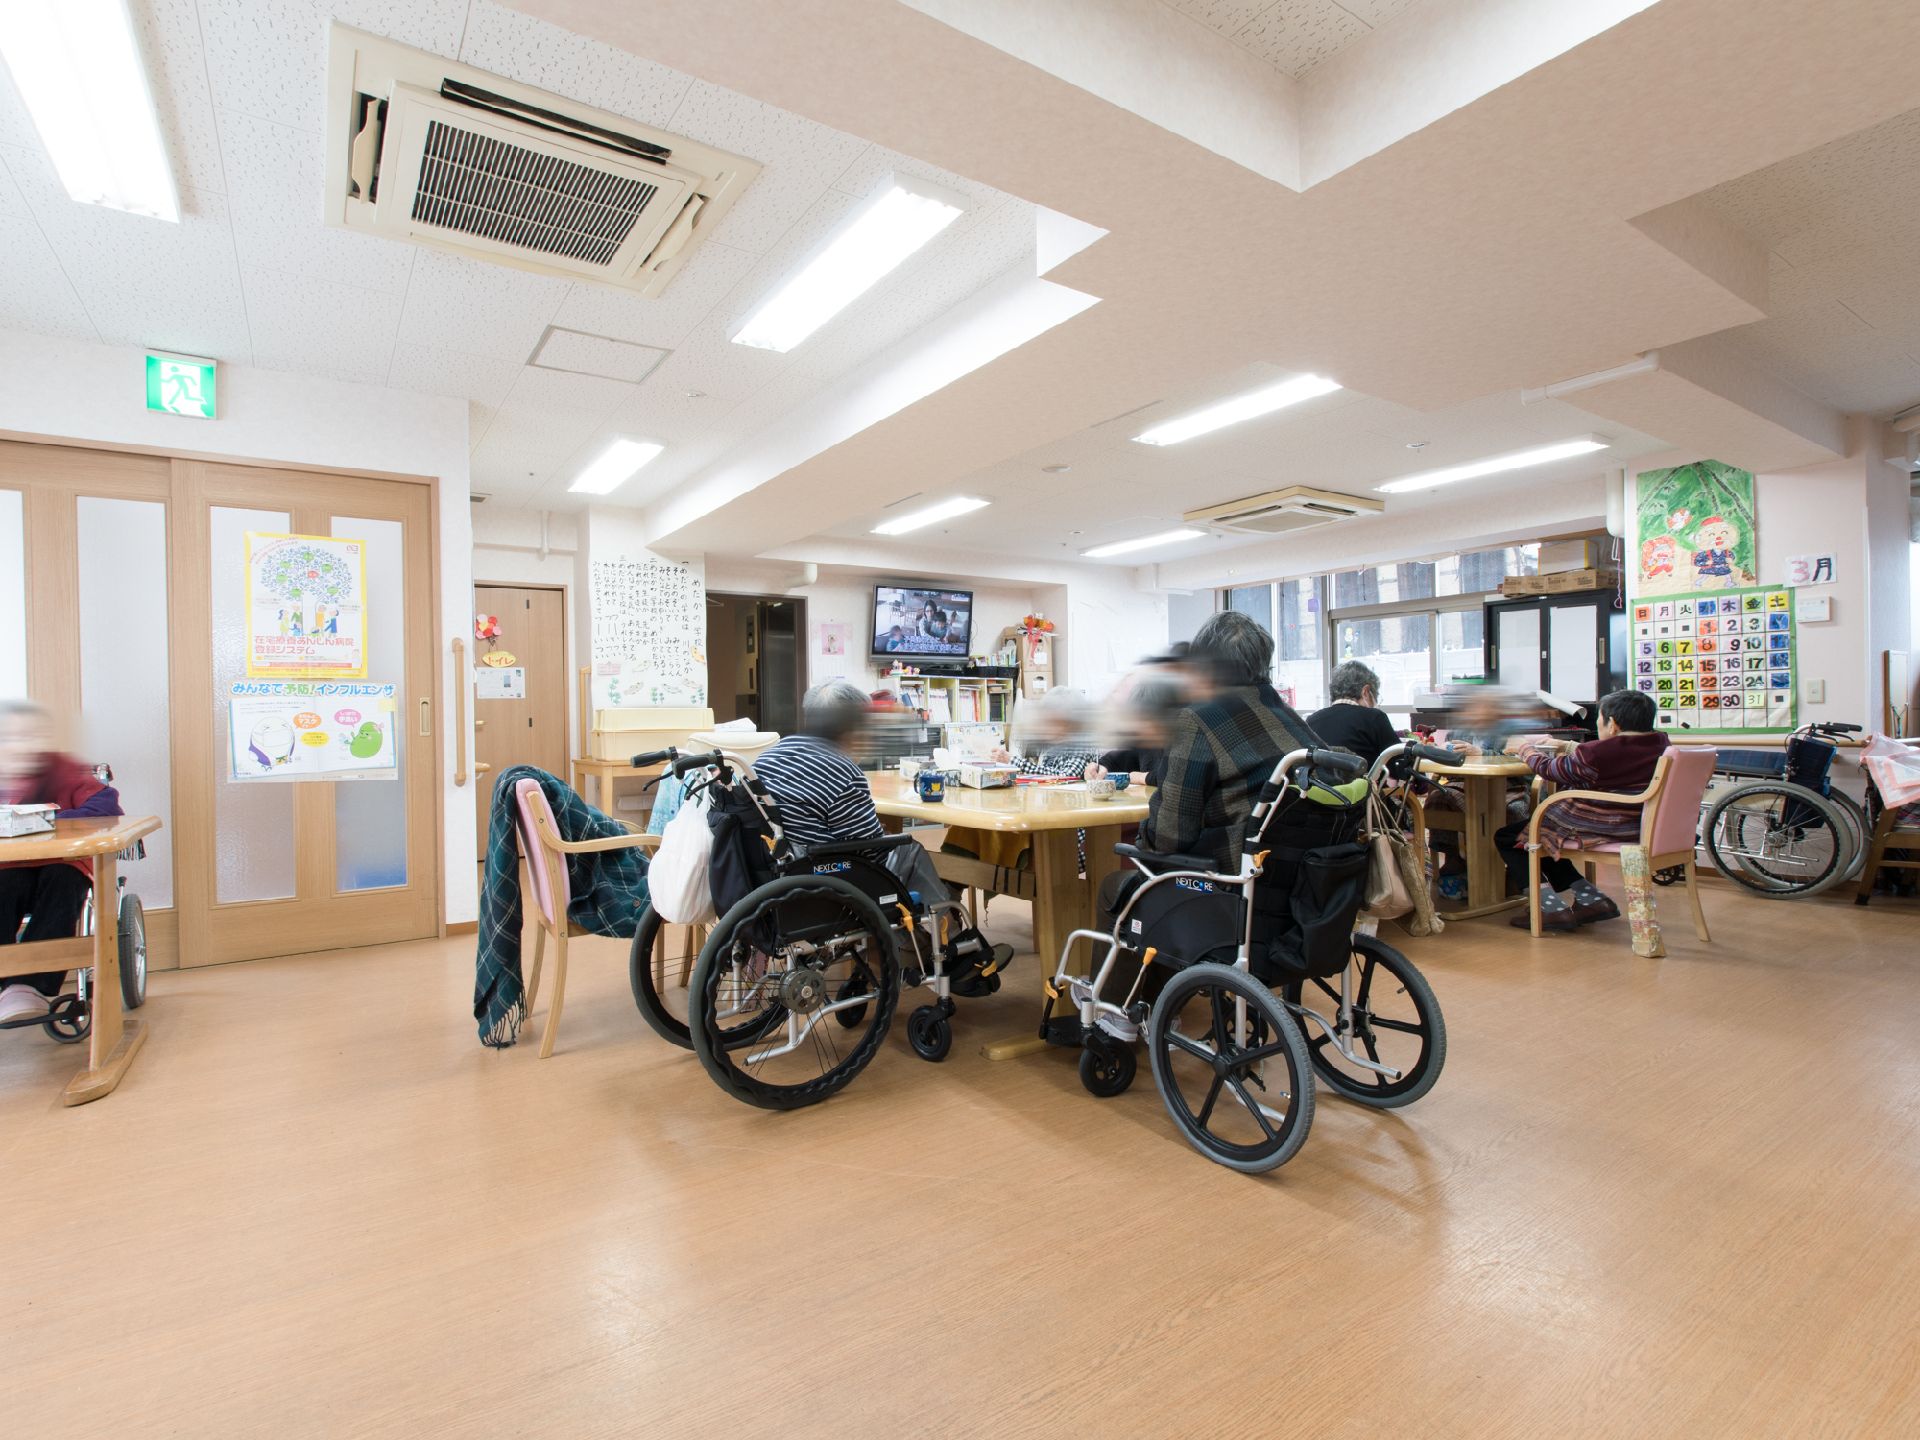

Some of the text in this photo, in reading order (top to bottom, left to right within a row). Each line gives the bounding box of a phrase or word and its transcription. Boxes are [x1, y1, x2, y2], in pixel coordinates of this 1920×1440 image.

[1791, 557, 1832, 583] 3月
[1638, 609, 1647, 617] 日
[1660, 607, 1669, 616] 月
[1680, 605, 1692, 614] 火
[1722, 601, 1736, 612] 木
[1746, 598, 1761, 610] 金
[1770, 596, 1785, 607] 土
[1727, 620, 1738, 631] 2
[1749, 618, 1760, 630] 3
[1643, 643, 1652, 654] 5
[1661, 642, 1669, 652] 6
[1680, 642, 1690, 652] 7
[1702, 638, 1712, 651] 8
[1731, 639, 1741, 650] 9
[1744, 638, 1761, 649] 10
[488, 656, 514, 665] トイレ
[1638, 662, 1651, 672] 12
[1657, 659, 1672, 670] 13
[1678, 660, 1693, 671] 14
[1700, 660, 1716, 671] 15
[1724, 658, 1740, 669] 16
[1746, 658, 1764, 669] 17
[1638, 680, 1652, 690] 19
[1658, 679, 1672, 690] 20
[1679, 679, 1694, 690] 21
[1701, 677, 1717, 687] 22
[1723, 676, 1740, 686] 23
[1745, 676, 1764, 686] 24
[1659, 694, 1761, 708] 27 28 29 30 31
